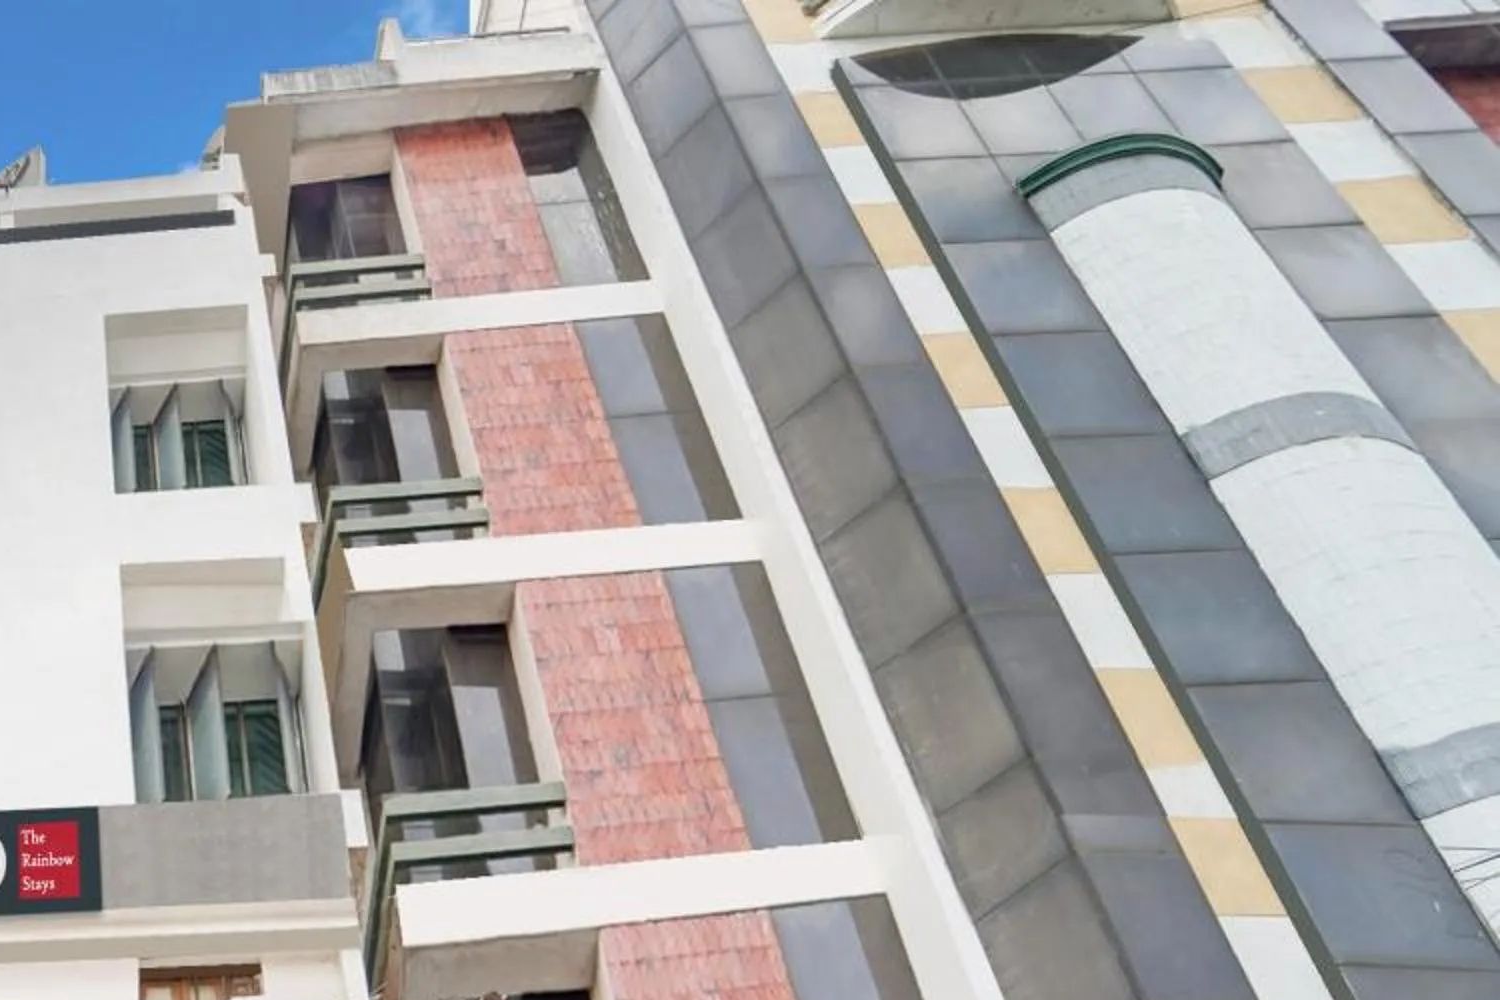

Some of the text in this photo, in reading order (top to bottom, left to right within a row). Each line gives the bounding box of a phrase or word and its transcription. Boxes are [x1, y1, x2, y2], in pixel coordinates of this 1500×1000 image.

[20, 828, 46, 845] The
[21, 851, 75, 867] Rainbow
[22, 875, 55, 895] Stays
